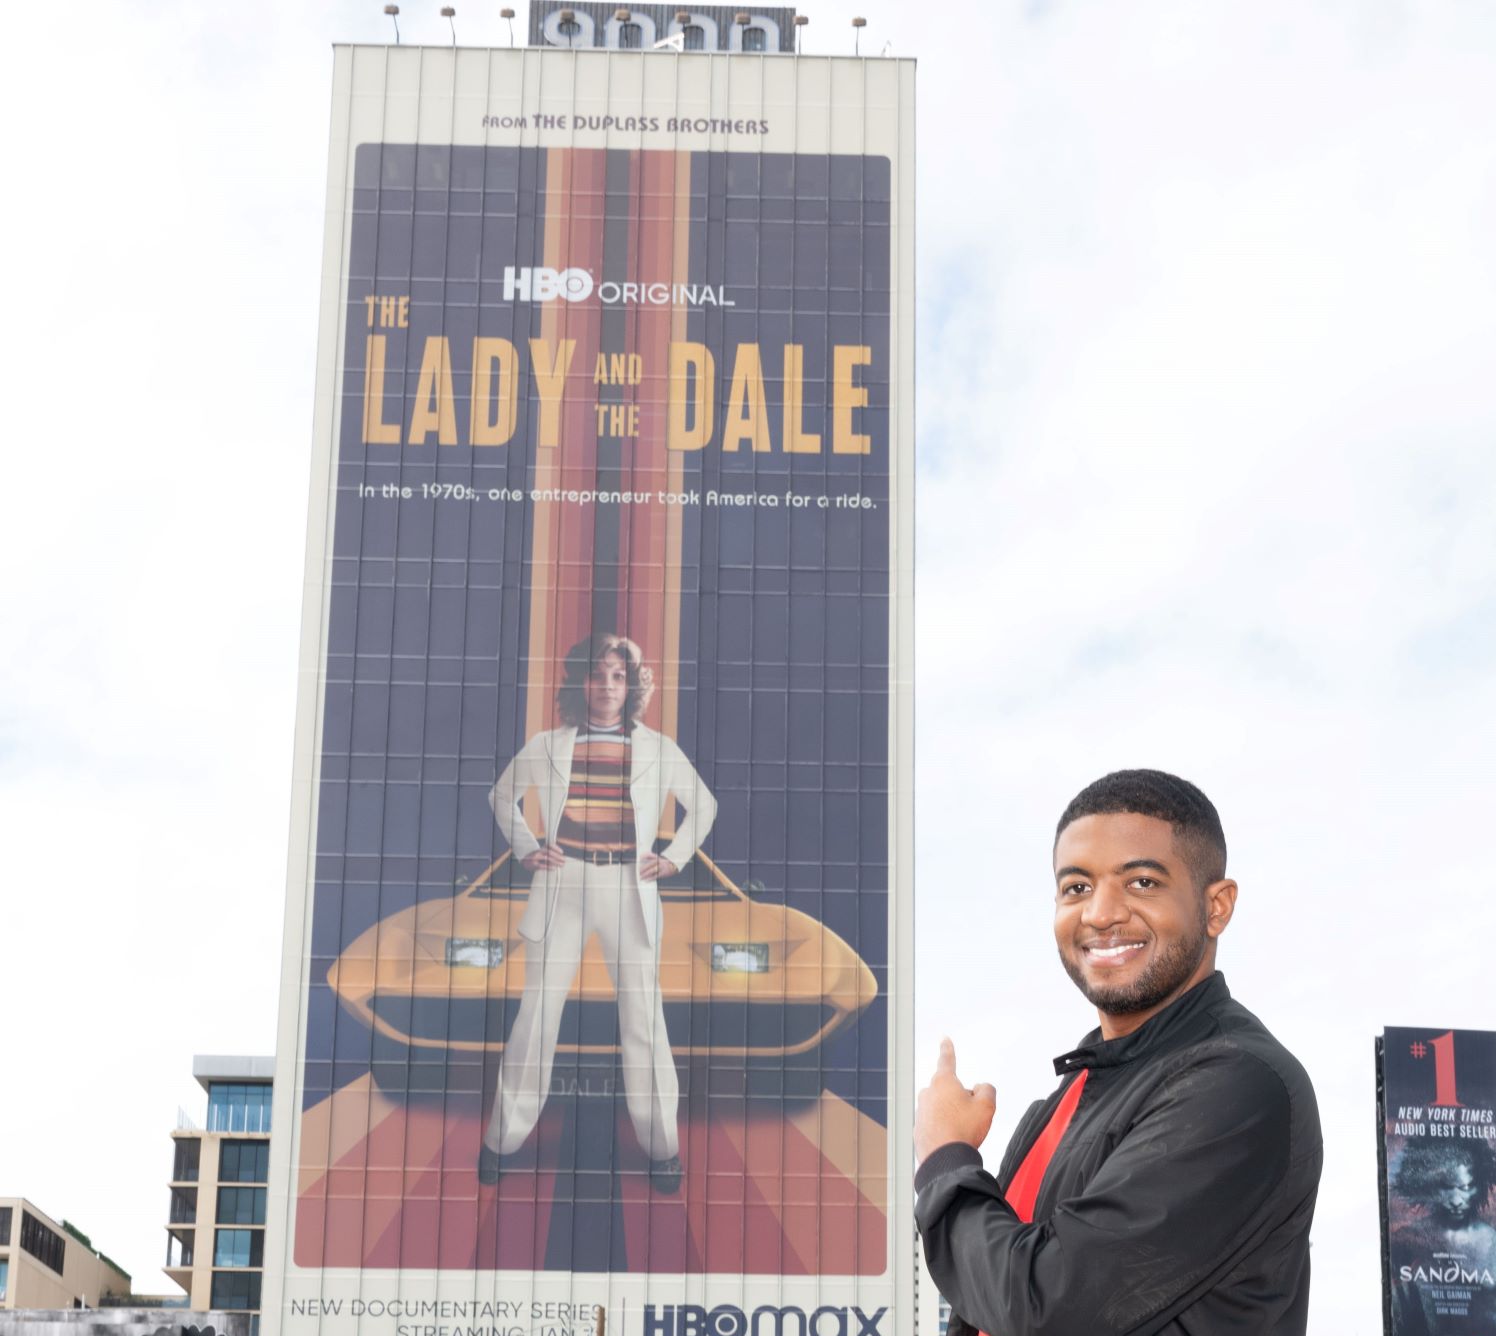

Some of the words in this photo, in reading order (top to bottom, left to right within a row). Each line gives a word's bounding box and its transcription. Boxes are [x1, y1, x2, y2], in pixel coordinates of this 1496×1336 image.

[482, 114, 527, 129] FROM
[533, 113, 567, 130] THE
[572, 115, 660, 132] DUPLASS
[666, 117, 769, 134] BROTHERS
[503, 266, 594, 302] HBO
[597, 281, 736, 306] ORIGINAL
[365, 296, 409, 328] THE
[593, 353, 643, 386] AND
[361, 334, 577, 448] LADY
[667, 341, 872, 455] DALE
[594, 405, 640, 438] THE
[359, 483, 375, 498] In
[382, 483, 412, 499] the
[421, 483, 480, 501] 1970s,
[488, 488, 523, 501] one
[530, 487, 651, 505] entrepreneur
[658, 490, 700, 505] took
[706, 490, 779, 507] America
[785, 491, 811, 508] for
[817, 495, 829, 508] a
[836, 492, 877, 509] ride.
[1410, 1029, 1466, 1108] #1
[1398, 1106, 1423, 1120] NEW
[1427, 1107, 1456, 1121] YORK
[1461, 1108, 1494, 1123] TIMES
[1394, 1123, 1426, 1136] AUDIO
[1430, 1124, 1455, 1138] BEST
[1459, 1124, 1496, 1139] SELLER
[291, 1298, 343, 1317] NEW
[350, 1299, 524, 1319] DOCUMENTARY
[530, 1302, 606, 1321] SERIES
[1431, 1290, 1445, 1299] NEIL
[1447, 1290, 1472, 1300] GAIMAN
